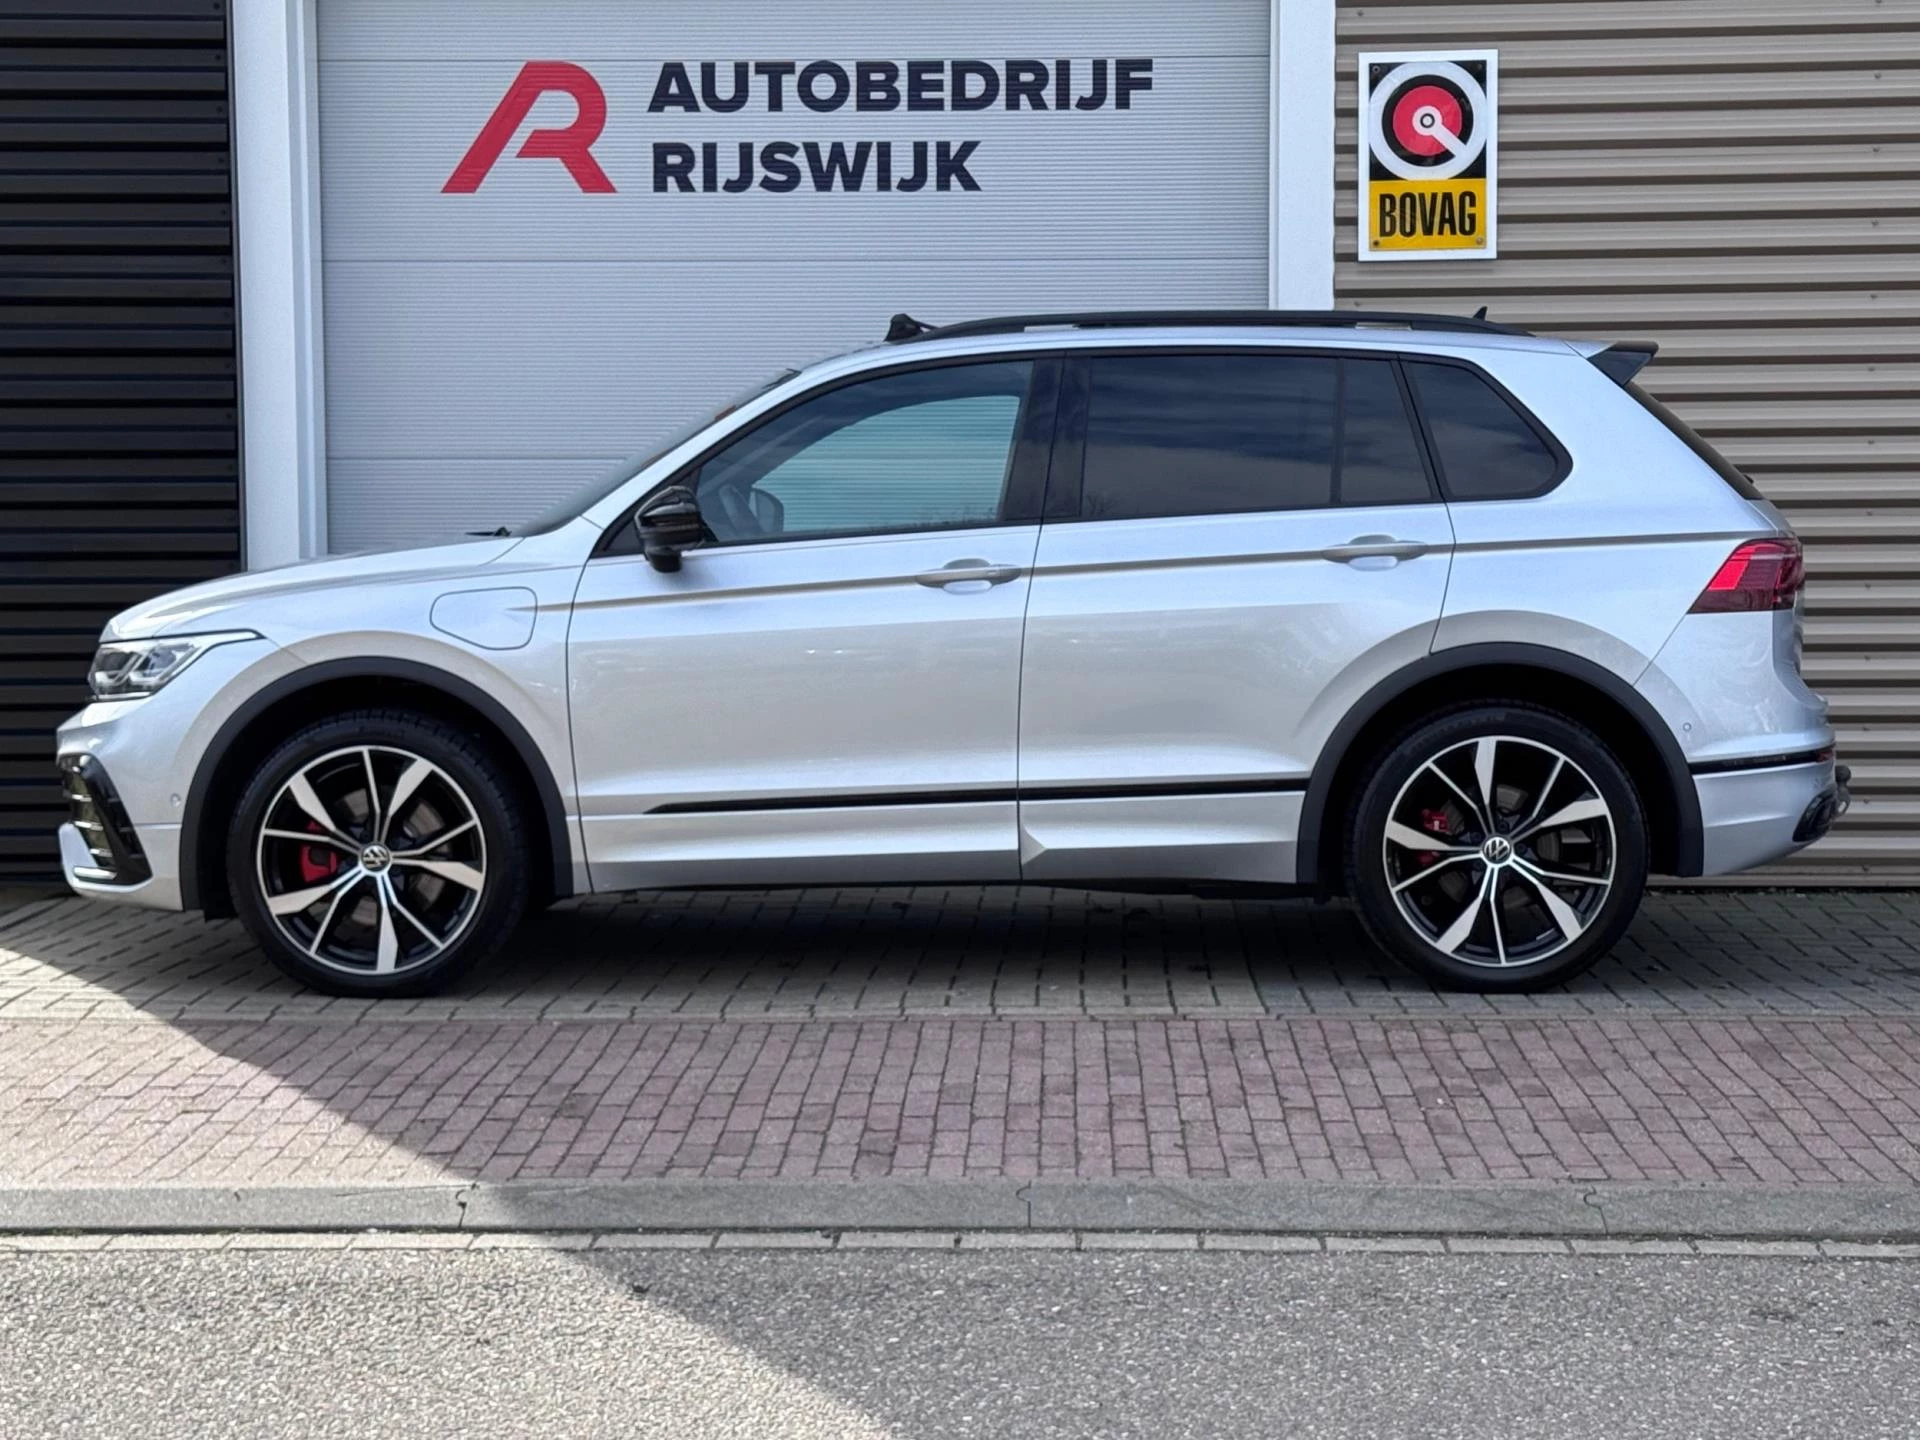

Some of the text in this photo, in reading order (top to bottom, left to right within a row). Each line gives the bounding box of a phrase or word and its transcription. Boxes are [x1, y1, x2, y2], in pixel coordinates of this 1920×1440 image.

[647, 58, 1154, 113] AUTOBEDRIJF
[652, 141, 982, 193] RIJSWIJK
[1379, 191, 1477, 237] BOVAG
